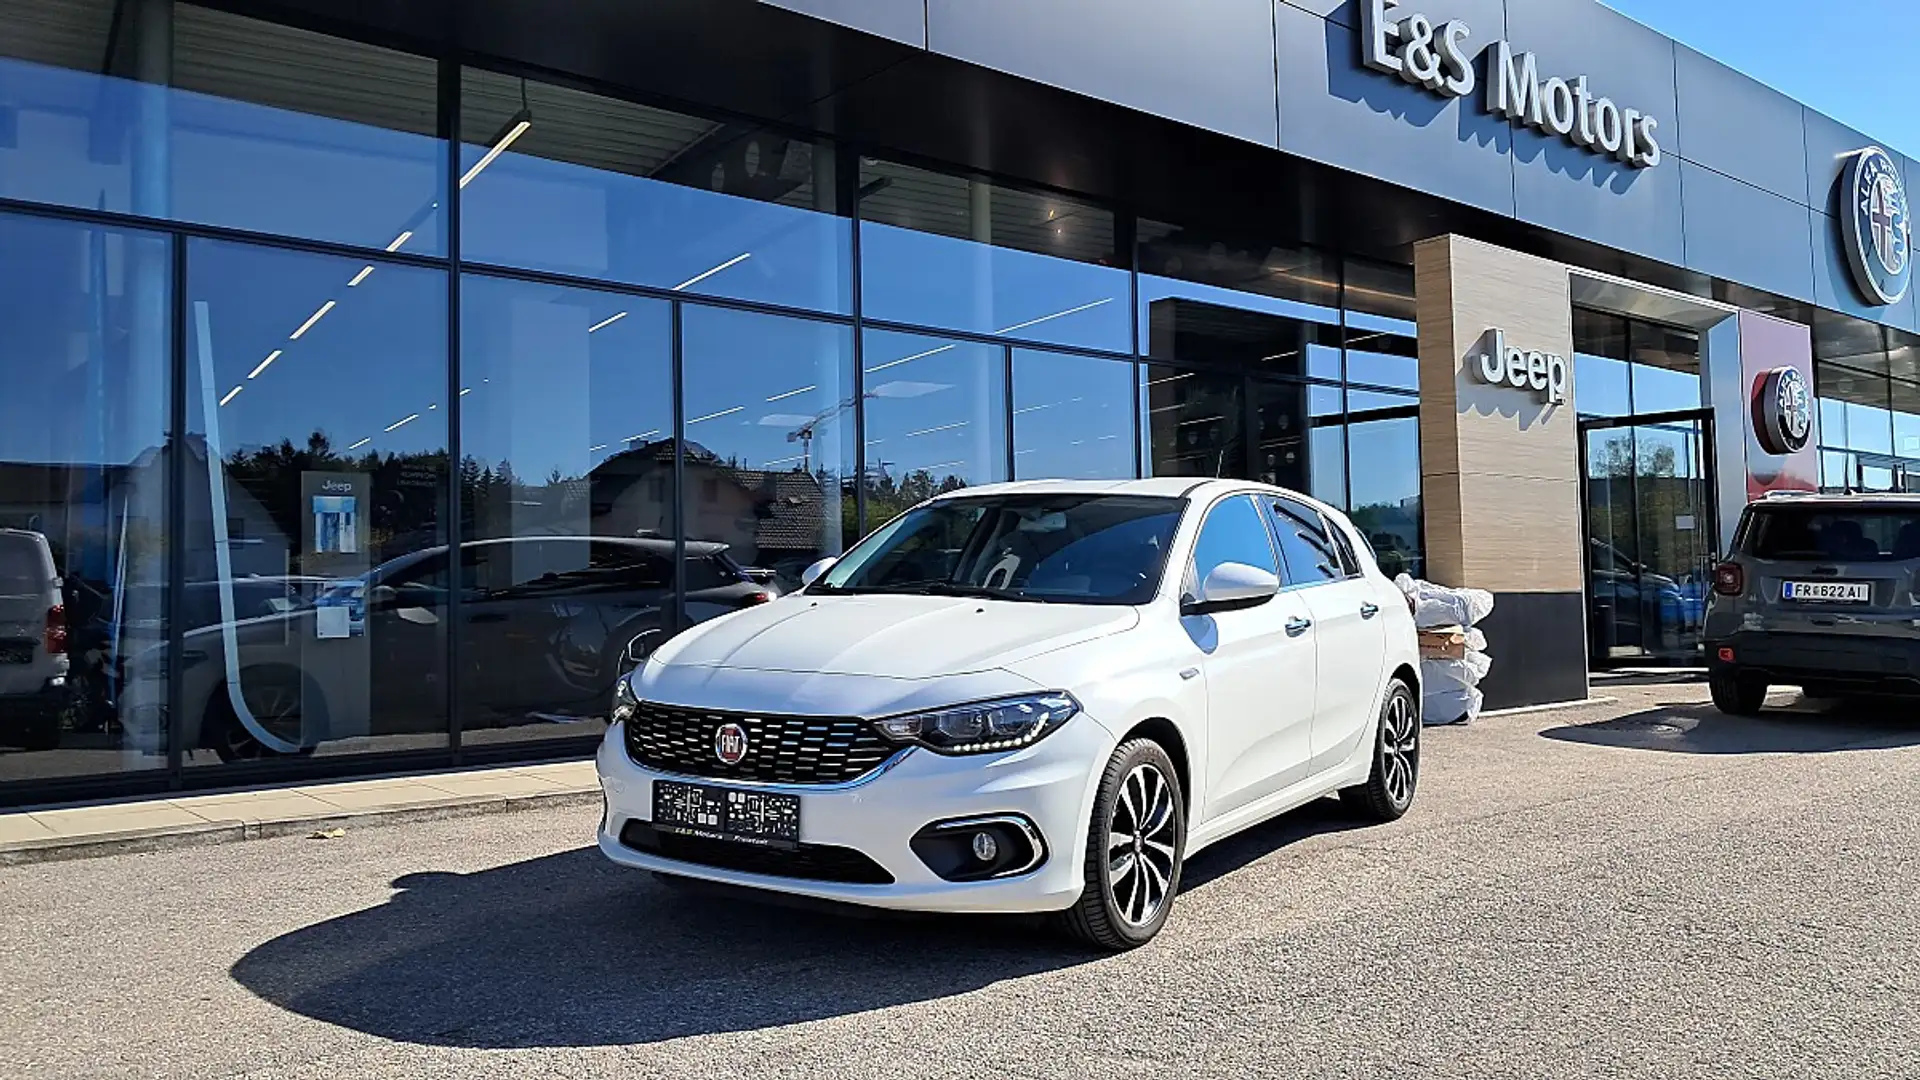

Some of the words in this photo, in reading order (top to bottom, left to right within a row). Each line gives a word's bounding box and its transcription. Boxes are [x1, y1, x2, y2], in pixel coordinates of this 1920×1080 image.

[1366, 0, 1475, 96] E&S
[1491, 40, 1661, 167] Motors
[1860, 160, 1879, 216] ALFA
[1480, 328, 1567, 404] Jeep
[321, 479, 352, 492] Jeep
[1795, 584, 1811, 596] FR
[721, 735, 740, 753] FIAT
